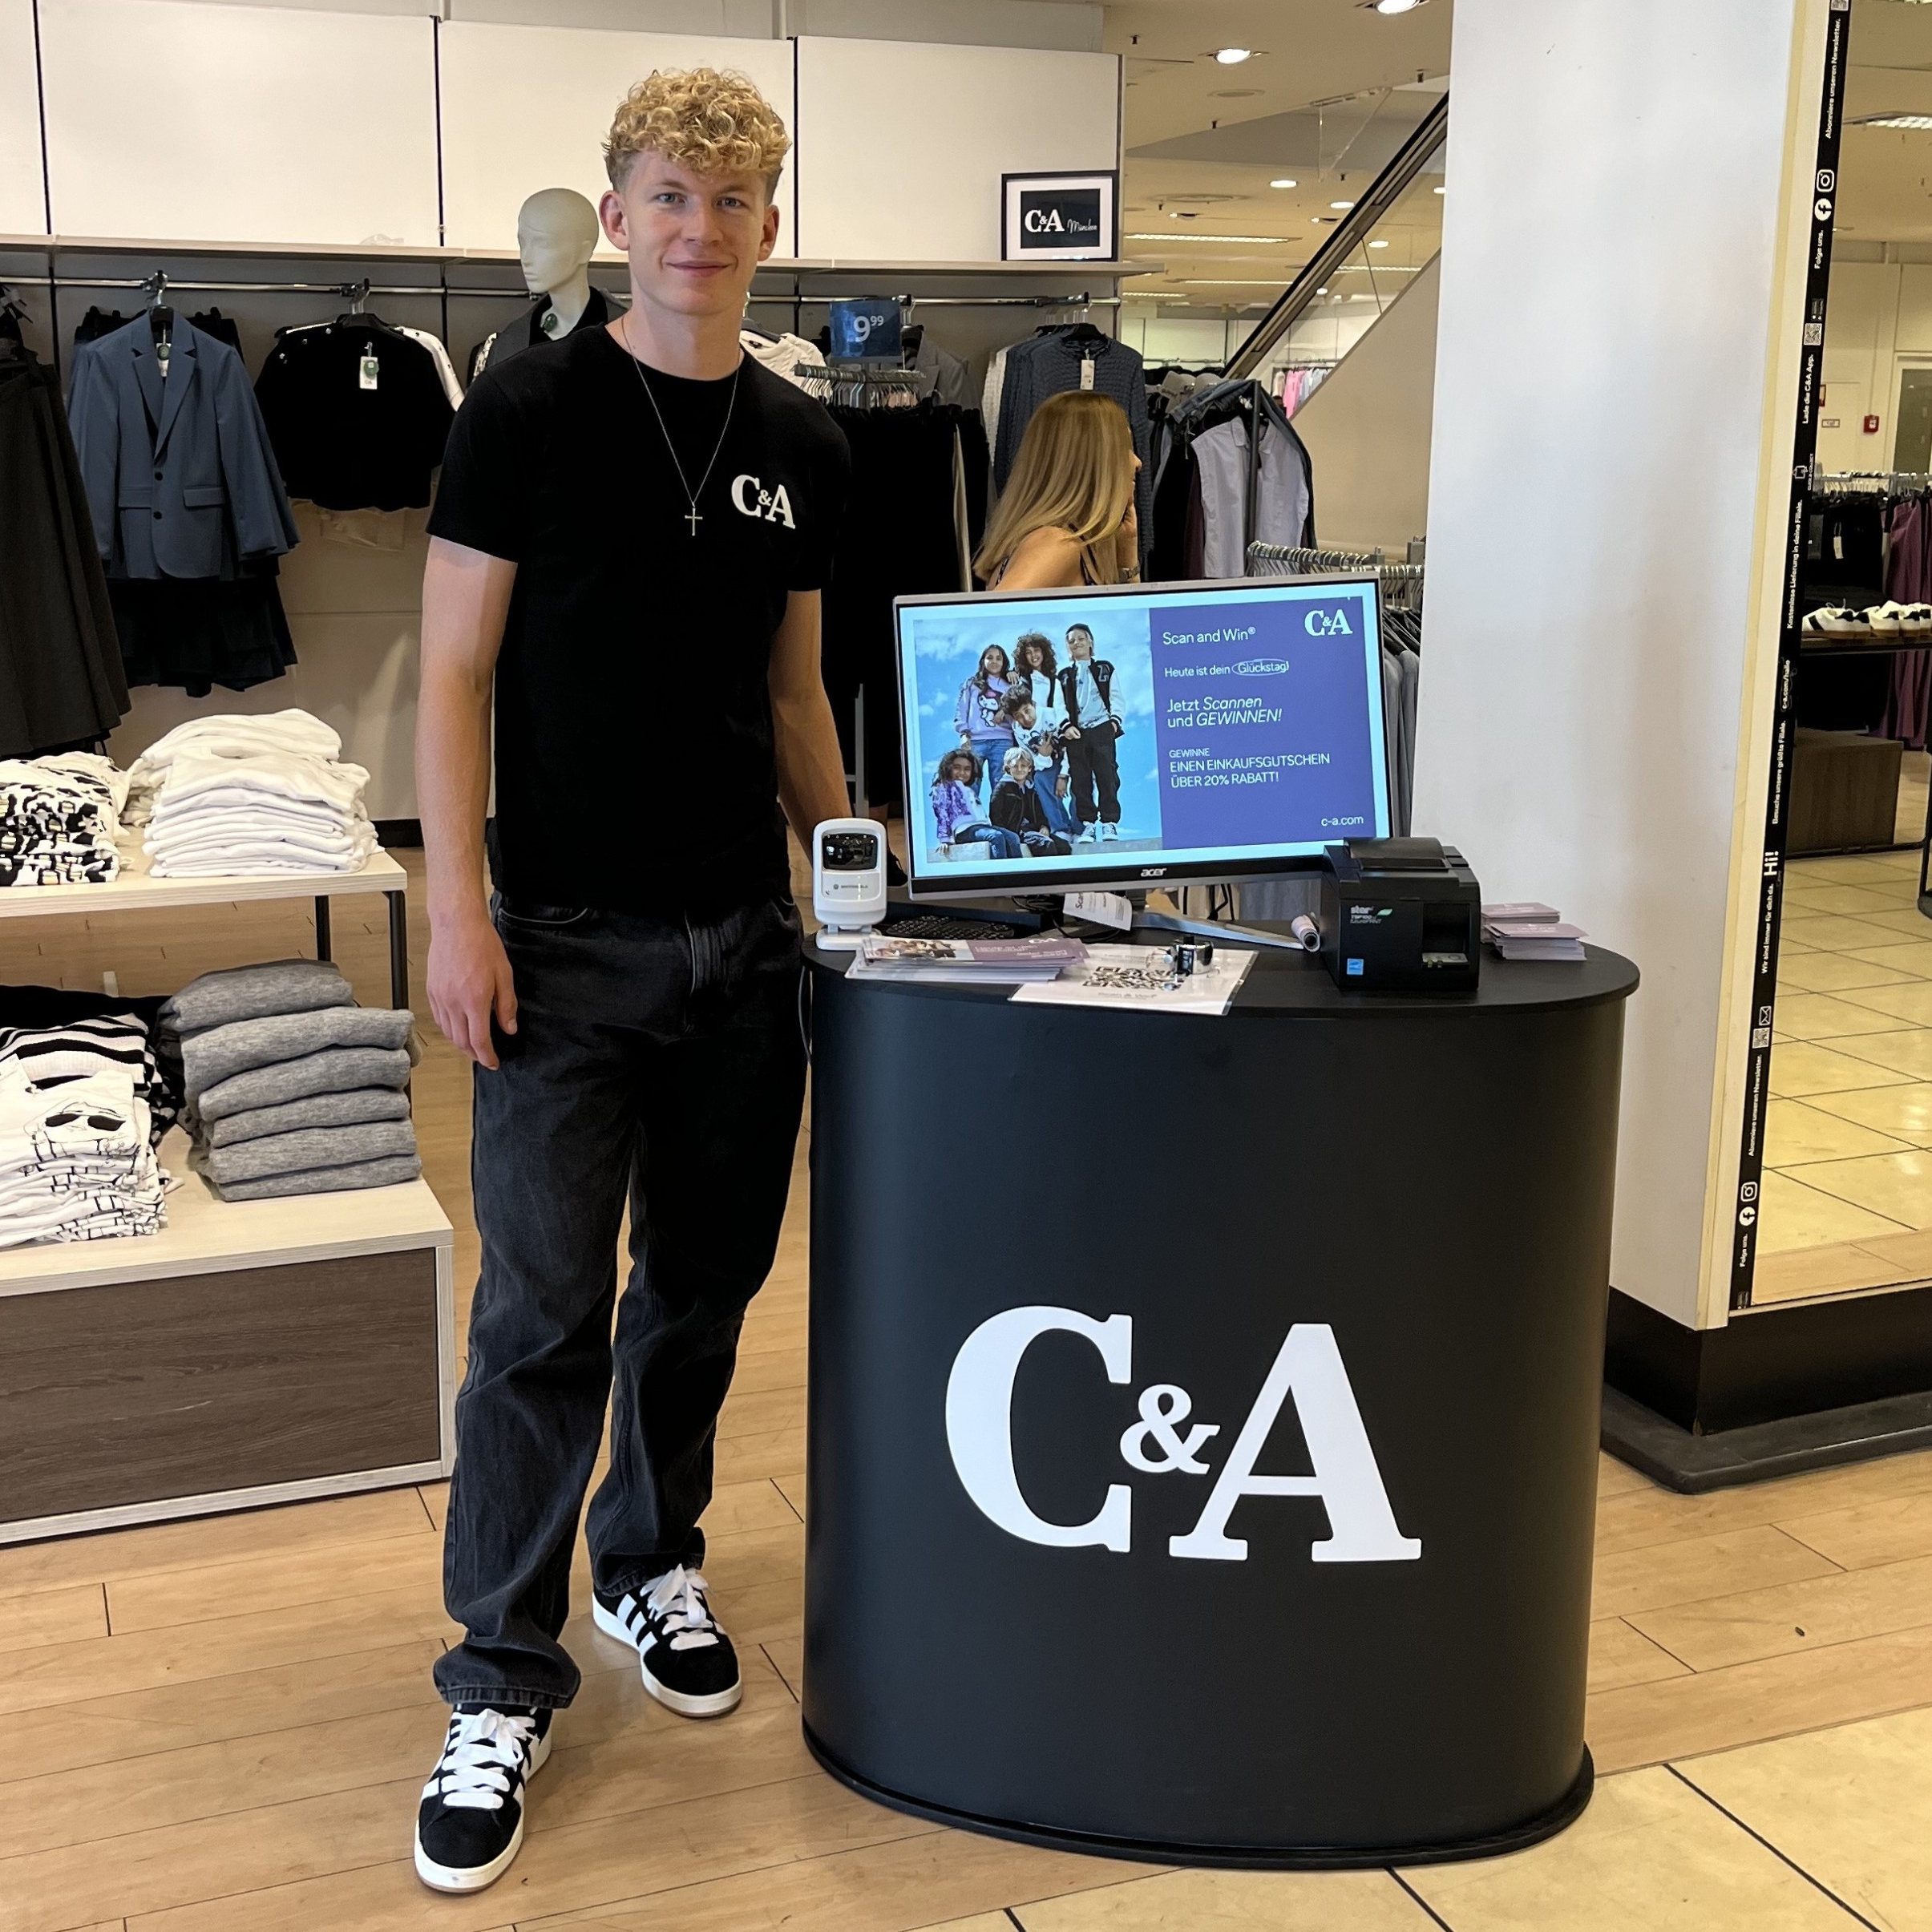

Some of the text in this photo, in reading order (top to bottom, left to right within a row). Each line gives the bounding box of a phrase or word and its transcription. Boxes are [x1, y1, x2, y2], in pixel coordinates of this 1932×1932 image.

[1825, 98, 1834, 139] Abonniere
[1831, 18, 1841, 63] Newsletter.
[1025, 208, 1065, 232] C&A
[1814, 248, 1823, 269] Folge
[1806, 354, 1814, 373] App.
[731, 474, 796, 530] C&A
[1790, 554, 1799, 588] Lieferung
[1787, 589, 1795, 629] Kostenlose
[1304, 609, 1352, 636] C&A
[1162, 632, 1194, 645] Scan
[1197, 629, 1221, 642] and
[1165, 666, 1194, 677] Heute
[1196, 666, 1207, 676] ist
[1210, 665, 1231, 675] dein
[1167, 697, 1262, 713] Jetzt Scannen
[1168, 709, 1282, 728] und GEWINNEN!
[1170, 748, 1210, 758] GEWINNE
[1170, 754, 1330, 772] EINEN EINKAUFSGUTSCHEIN
[1171, 771, 1279, 788] ÜBER 20% RABATT!
[1321, 815, 1364, 827] c-a.com
[1141, 867, 1167, 877] acer
[1762, 851, 1779, 875] Hi!
[1748, 1122, 1756, 1156] Abonniere
[1753, 1055, 1761, 1093] Newsletter.
[1740, 1249, 1748, 1267] Folge
[945, 1306, 1422, 1562] C&A
